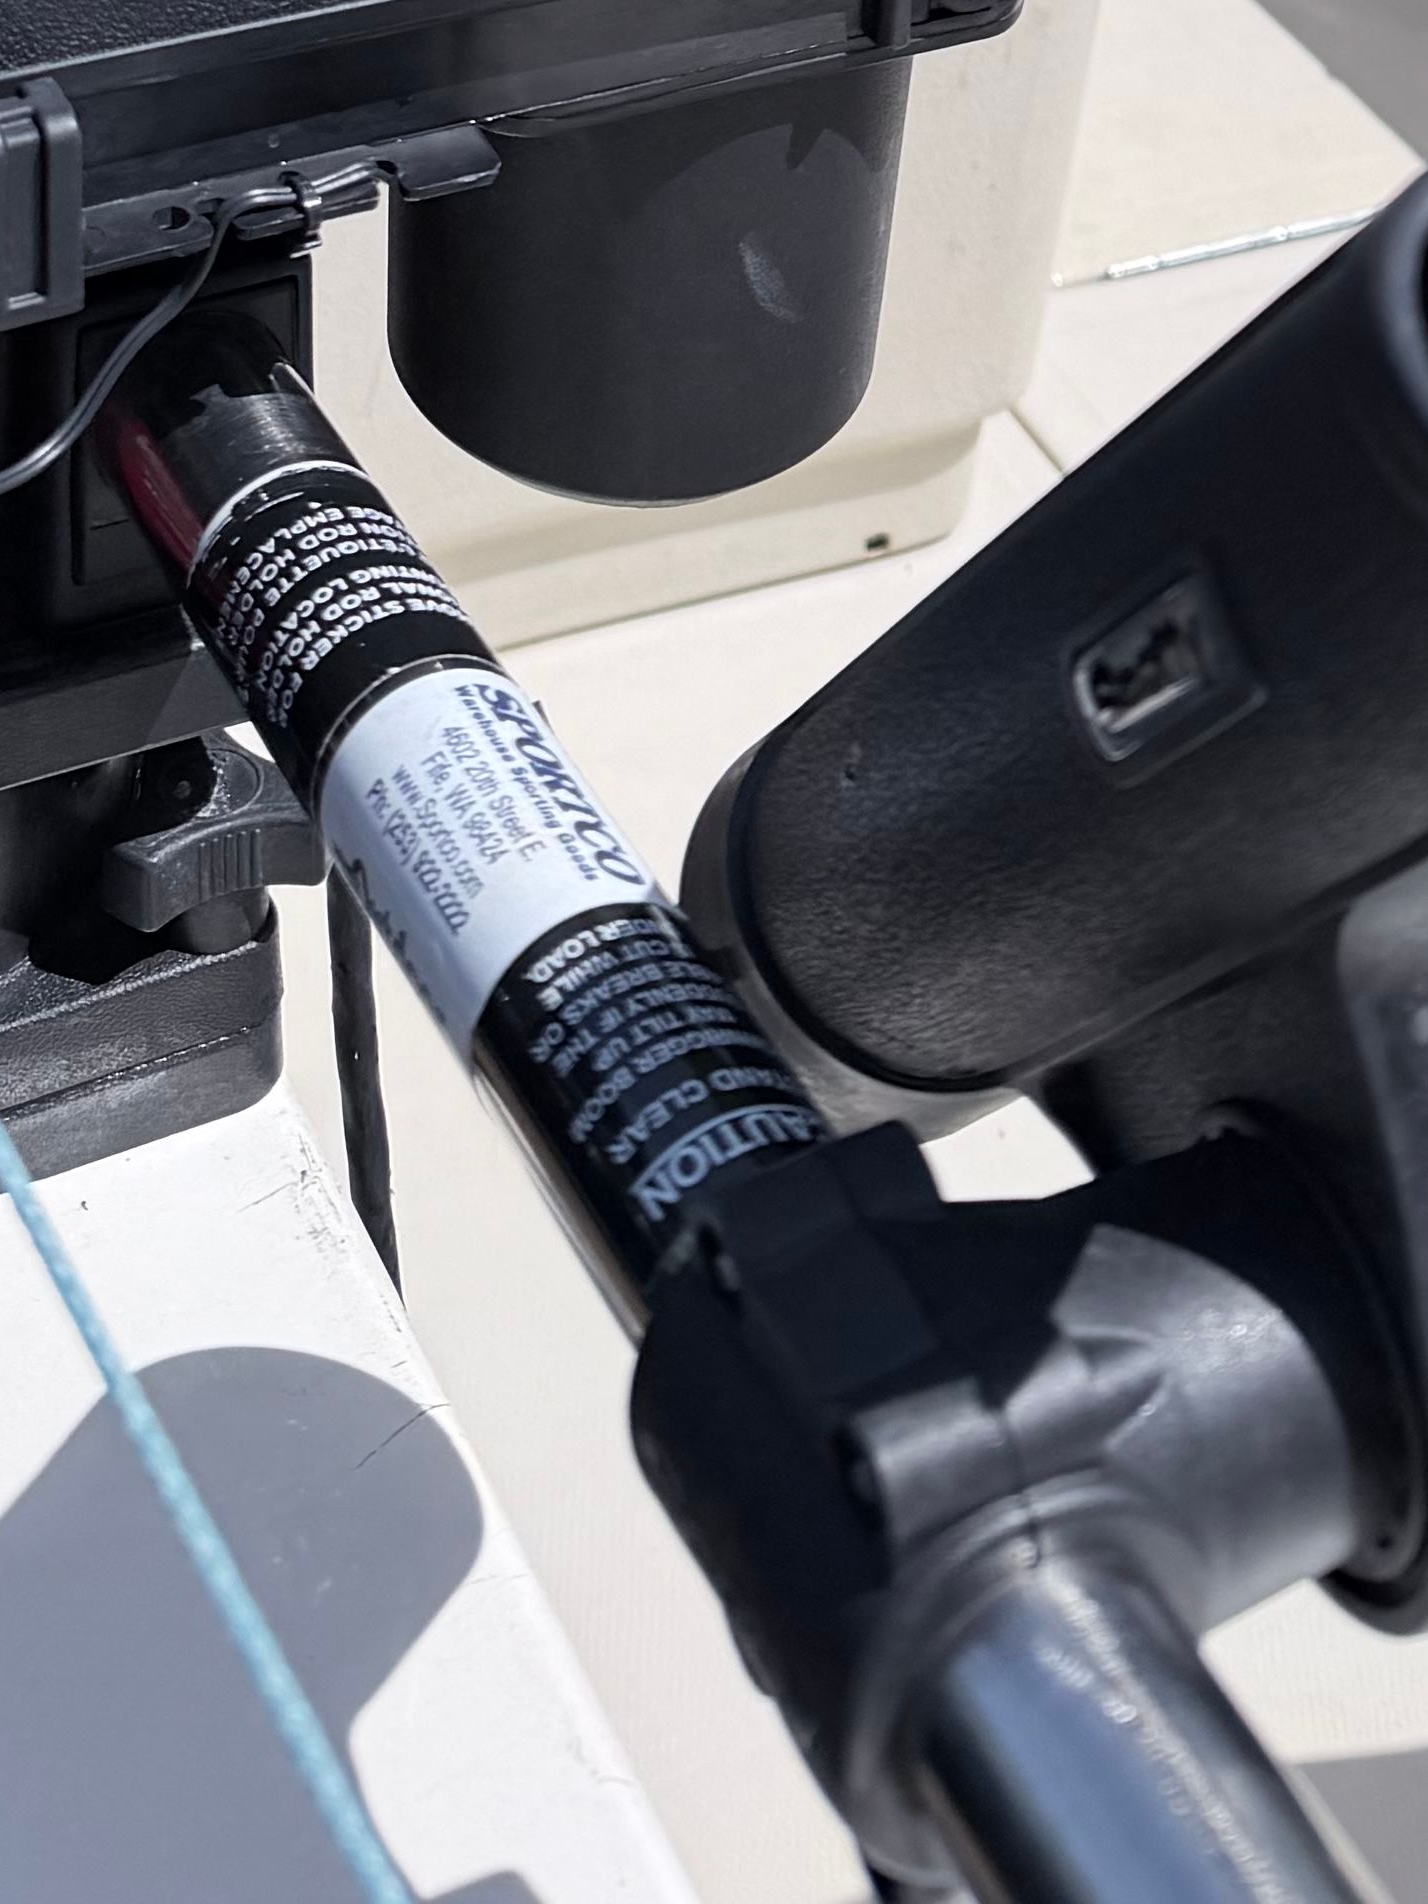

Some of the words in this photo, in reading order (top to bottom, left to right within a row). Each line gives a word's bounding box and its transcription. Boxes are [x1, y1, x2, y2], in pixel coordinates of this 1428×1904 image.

[298, 522, 358, 551] ROD
[299, 599, 406, 672] STICKER
[322, 586, 382, 622] ROD
[440, 726, 481, 763] 4602
[488, 795, 533, 845] Street
[454, 684, 516, 763] Warehouse
[510, 761, 561, 830] Sporting
[556, 832, 600, 882] Goods
[472, 683, 647, 886] SPORTCO
[537, 951, 620, 1012] WHILE
[557, 961, 664, 1026] BREAKS
[597, 1007, 623, 1034] IF
[628, 1011, 685, 1044] TILT
[551, 1029, 602, 1079] THE
[590, 1037, 631, 1072] UP
[569, 1067, 636, 1143] BOOM
[604, 1078, 709, 1165] CLEAR
[635, 1111, 818, 1223] AUTION
